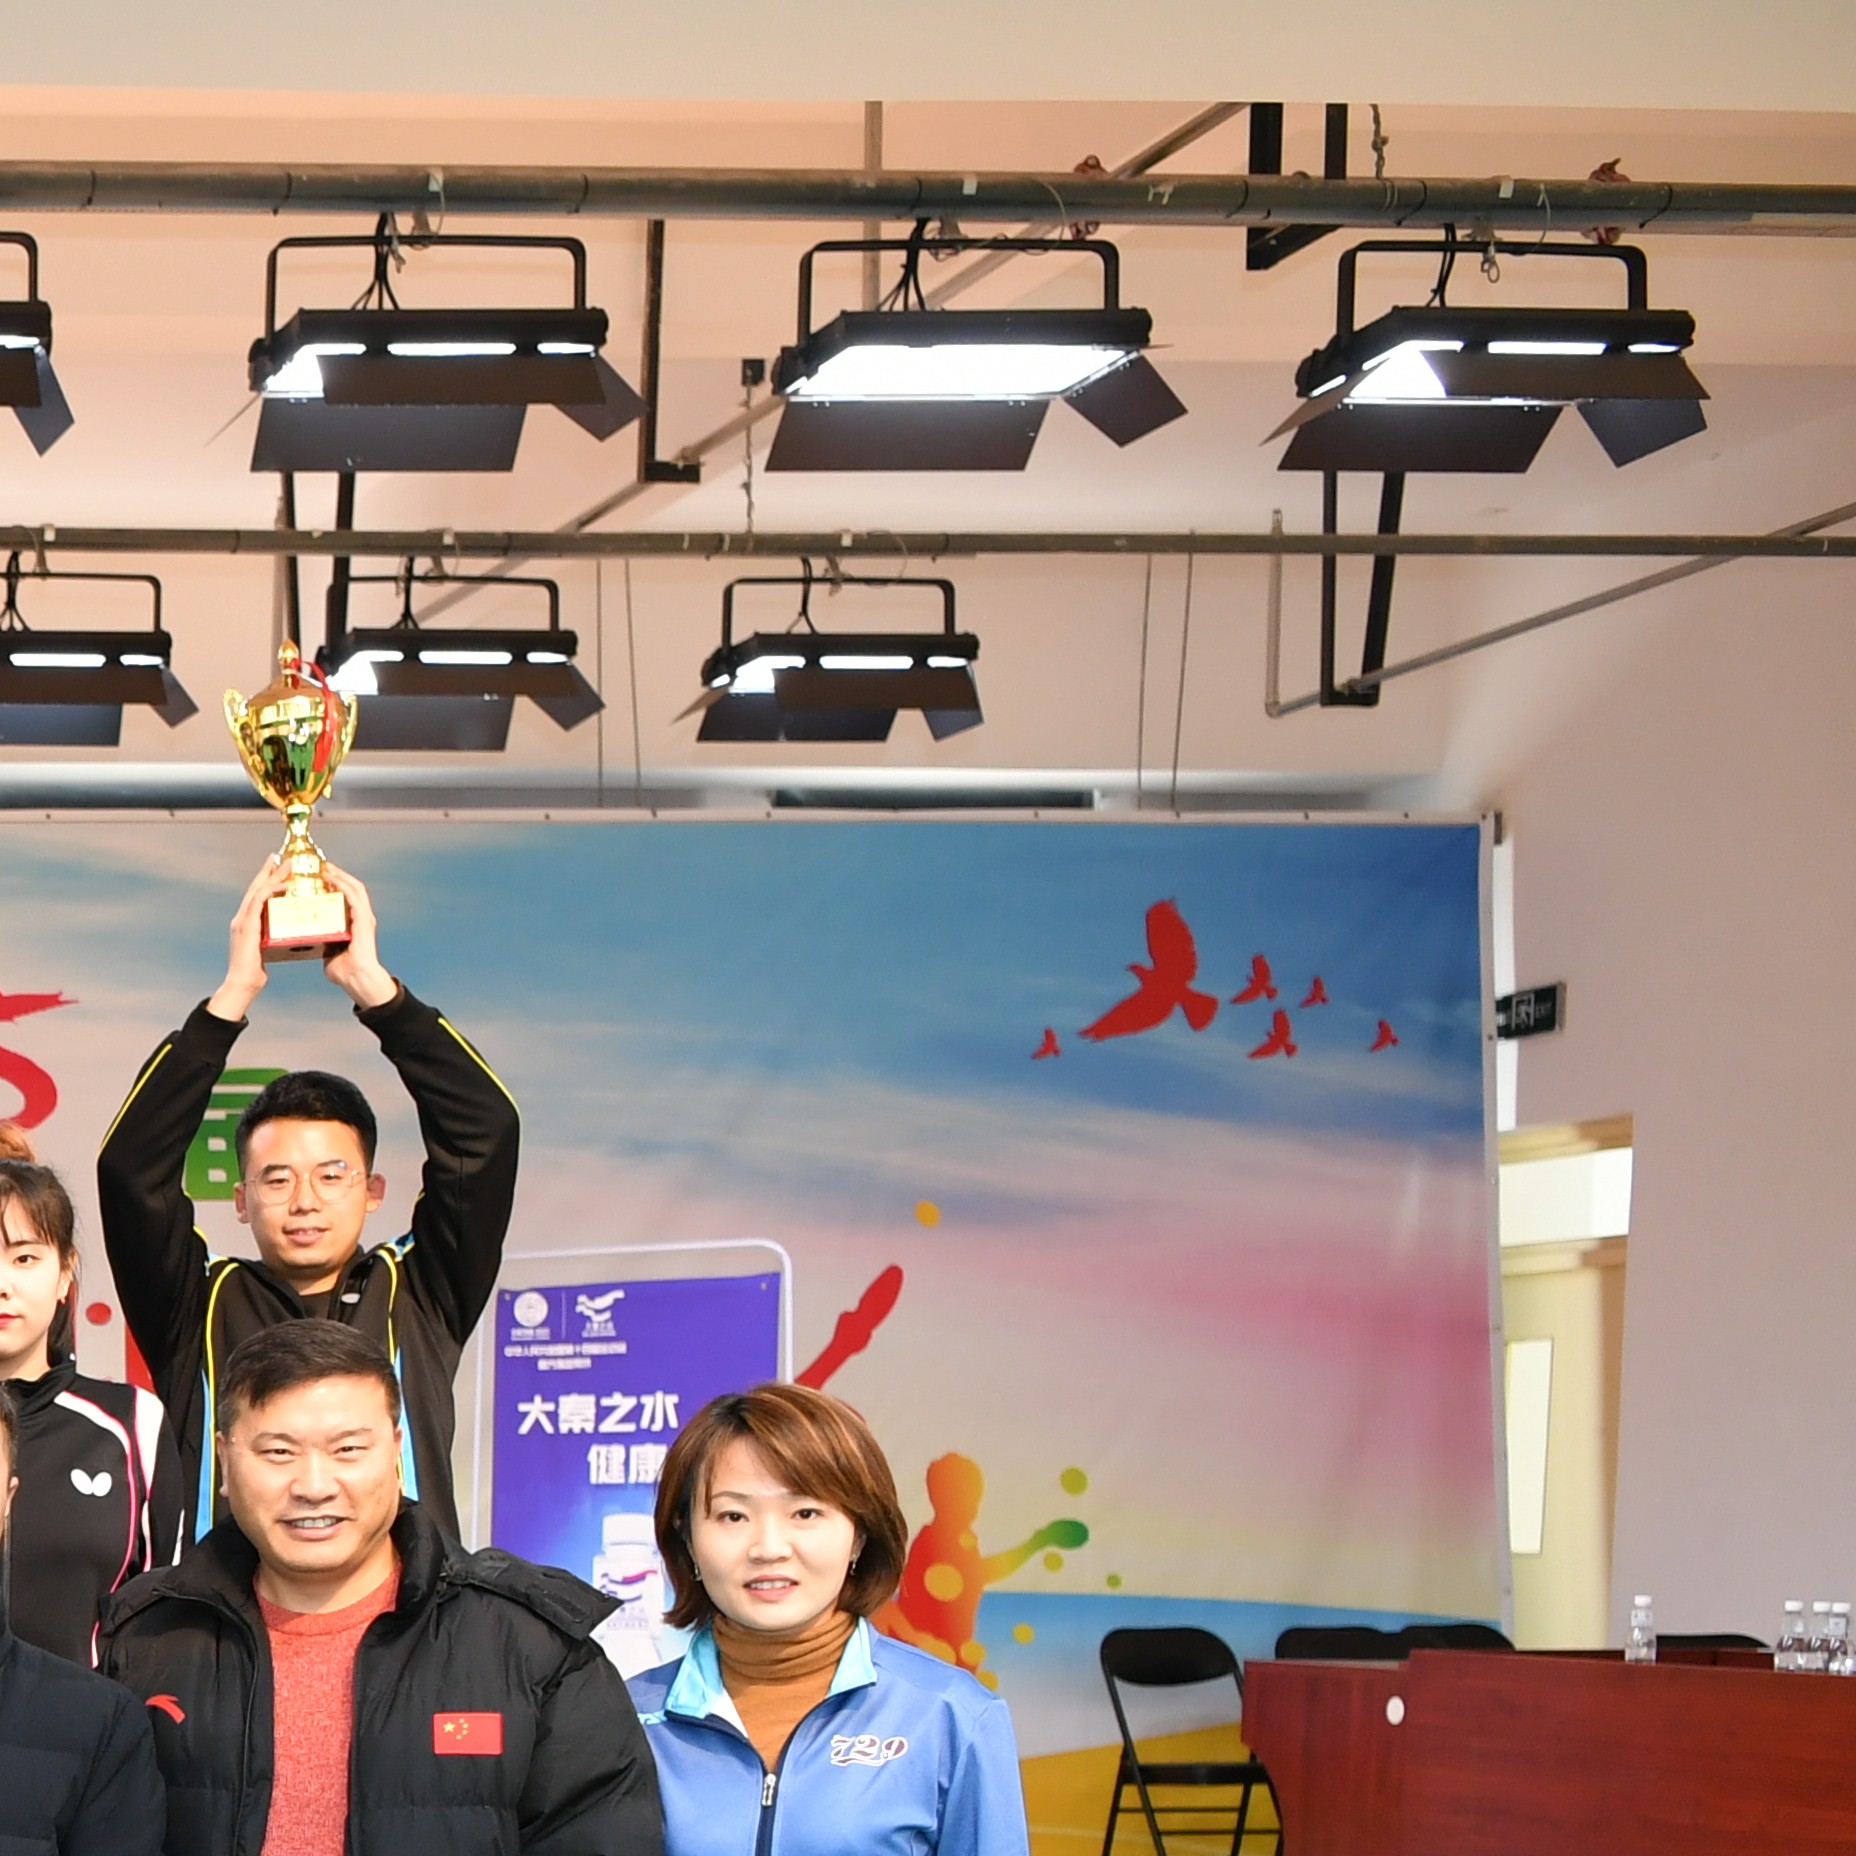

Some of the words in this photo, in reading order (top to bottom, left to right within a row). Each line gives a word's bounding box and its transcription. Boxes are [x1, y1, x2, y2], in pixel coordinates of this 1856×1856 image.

[517, 1391, 680, 1435] 大秦之水
[831, 1734, 908, 1767] 729
